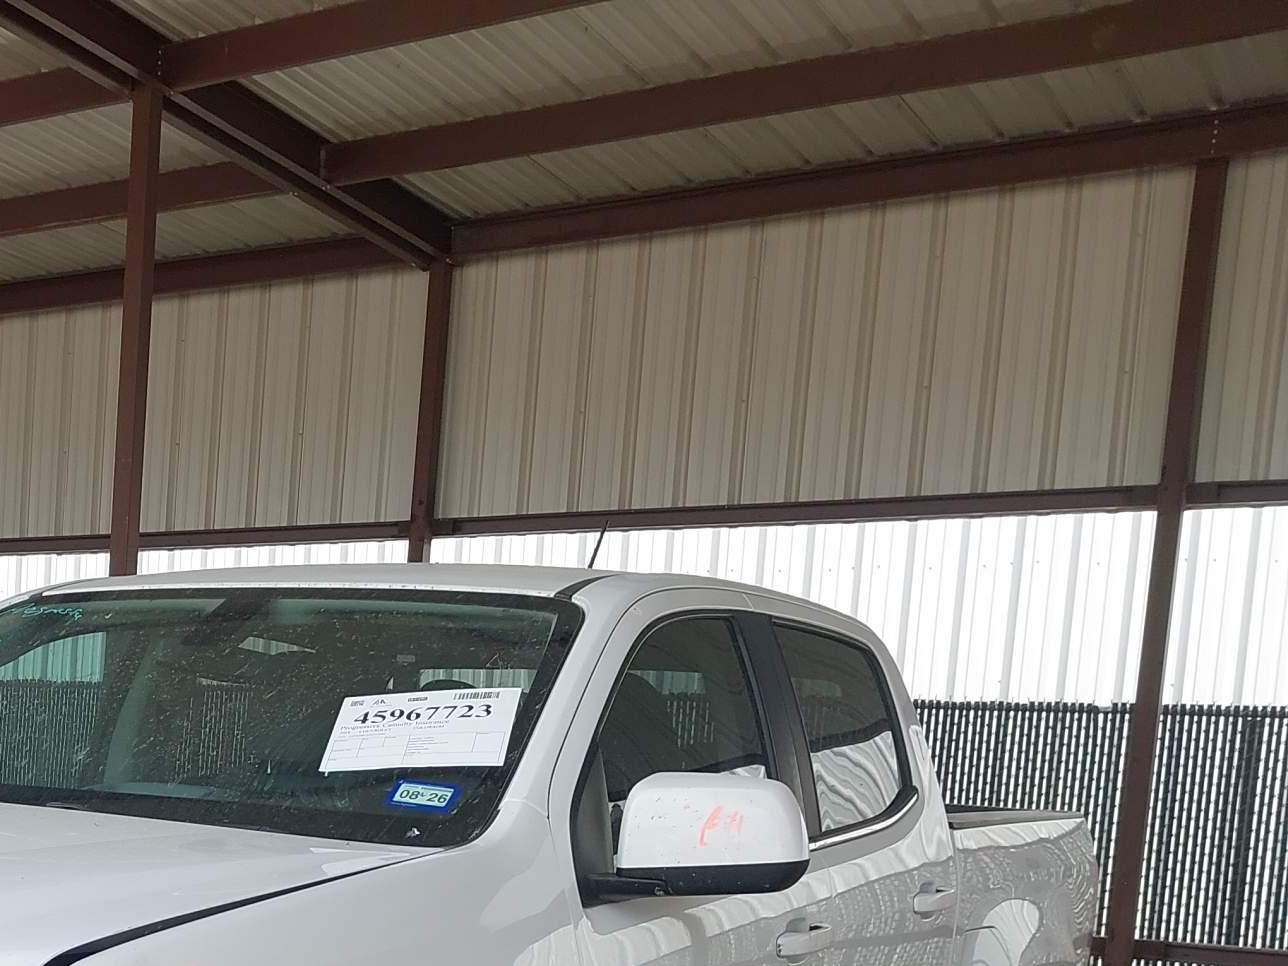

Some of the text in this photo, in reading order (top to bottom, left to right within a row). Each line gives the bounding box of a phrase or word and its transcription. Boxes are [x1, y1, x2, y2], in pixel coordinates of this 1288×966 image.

[353, 704, 493, 725] 45967723
[399, 789, 448, 804] 08 26
